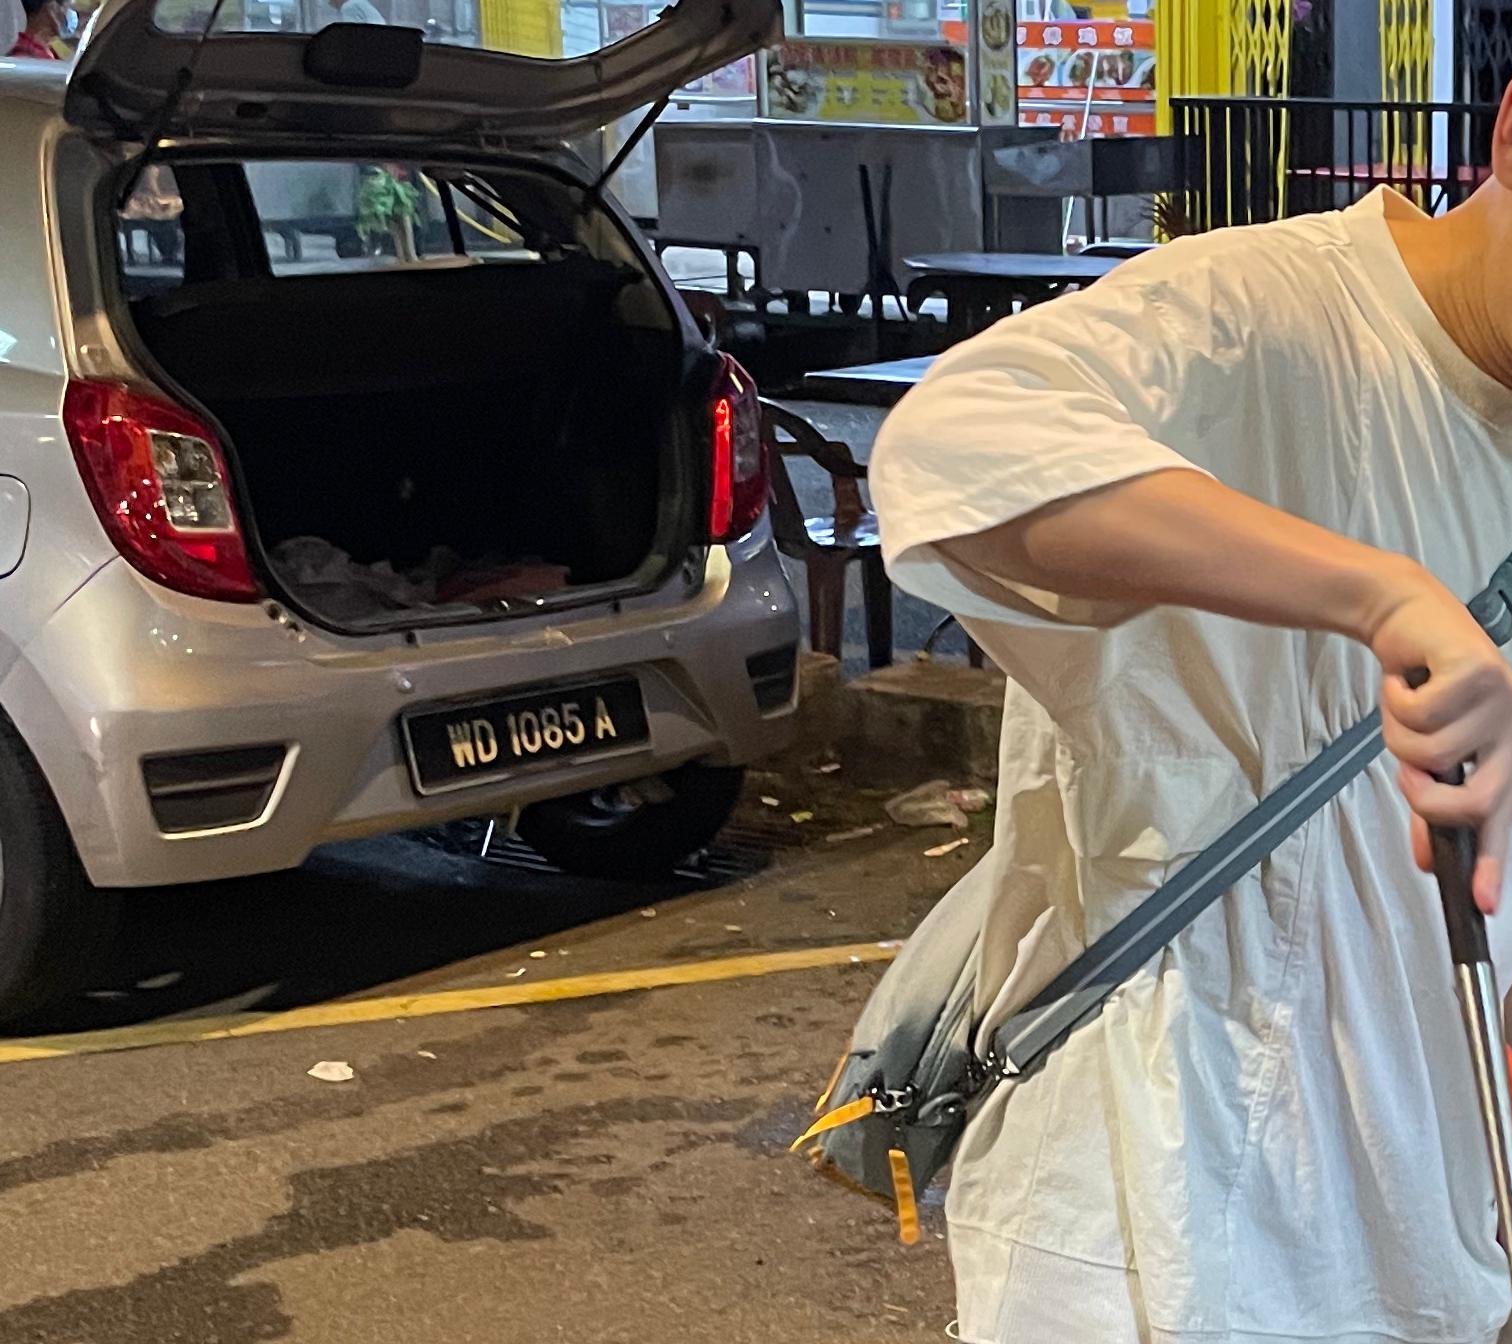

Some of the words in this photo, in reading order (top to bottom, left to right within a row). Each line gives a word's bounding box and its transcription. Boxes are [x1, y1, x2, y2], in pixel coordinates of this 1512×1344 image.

[447, 718, 498, 768] WD
[506, 702, 586, 756] 1085
[595, 696, 617, 740] A
